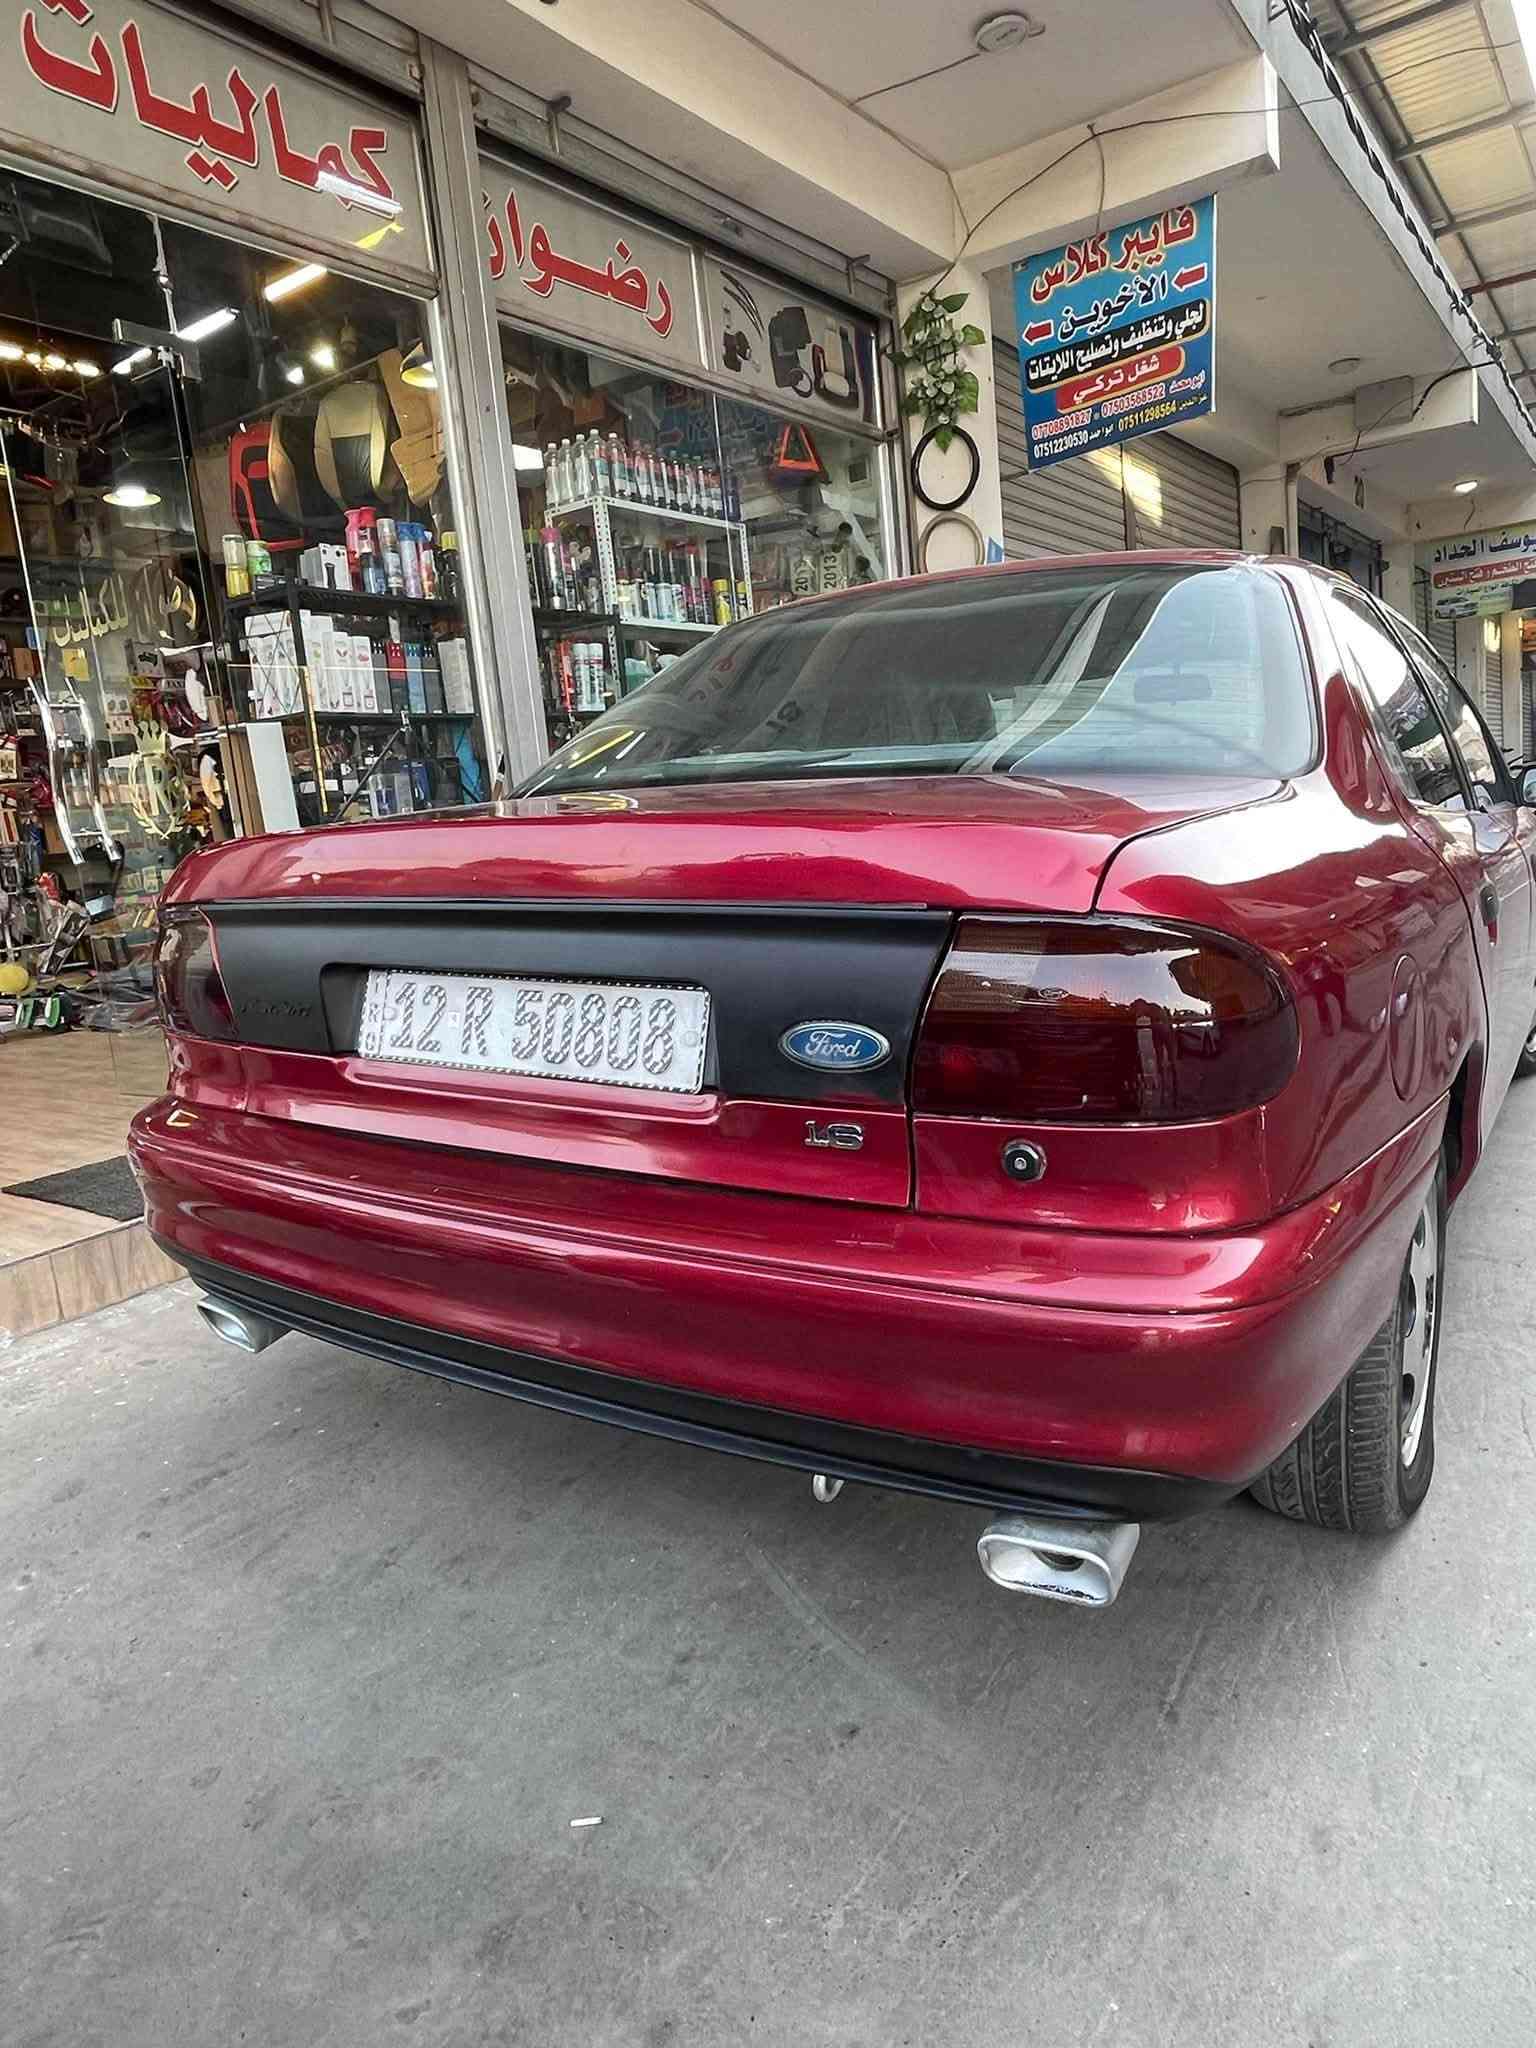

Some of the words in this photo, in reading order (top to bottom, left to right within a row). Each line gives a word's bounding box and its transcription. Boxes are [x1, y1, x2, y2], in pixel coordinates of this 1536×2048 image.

[21, 0, 397, 219] كماليات
[1114, 206, 1197, 272] فايبر
[1075, 334, 1120, 371] وتصليح
[1121, 317, 1173, 351] وتنظيف
[1073, 367, 1124, 404] تركي
[1128, 353, 1161, 381] شغل
[824, 555, 837, 590] 2013
[389, 982, 448, 1052] 12
[461, 986, 495, 1057] R
[511, 988, 679, 1076] 50808
[804, 1030, 862, 1058] Ford
